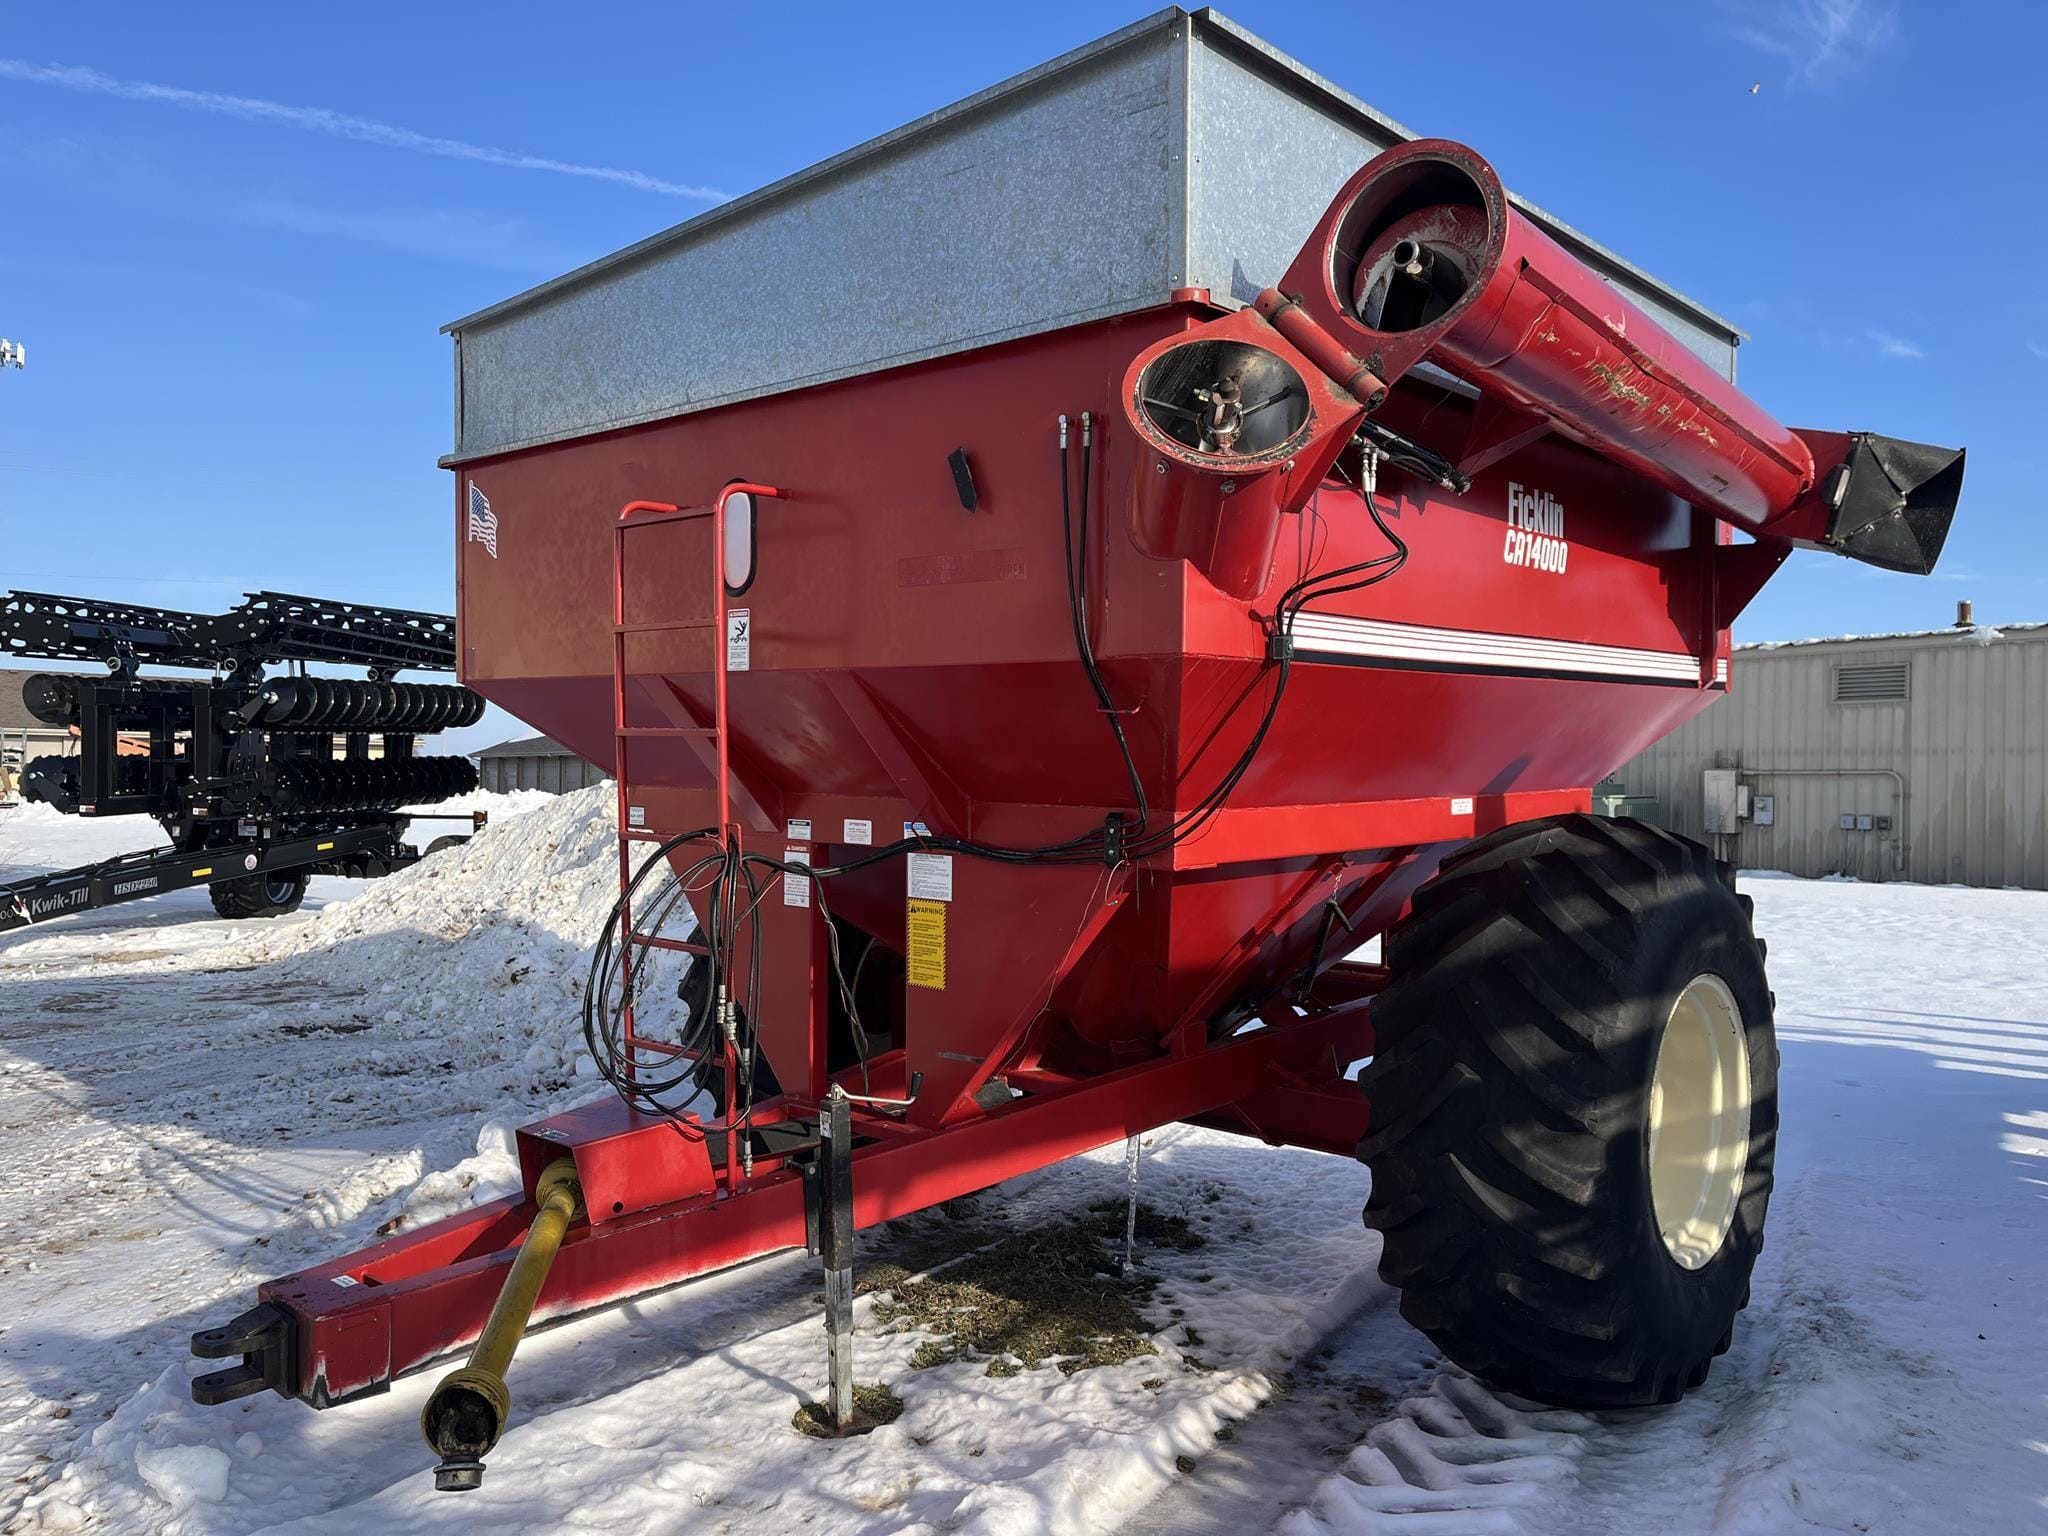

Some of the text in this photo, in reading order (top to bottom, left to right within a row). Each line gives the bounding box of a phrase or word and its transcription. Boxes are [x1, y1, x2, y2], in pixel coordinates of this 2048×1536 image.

[1508, 481, 1564, 538] Ficklin
[1503, 529, 1568, 575] CA14000
[31, 886, 89, 916] Kwik-Till
[915, 906, 944, 916] WARNING
